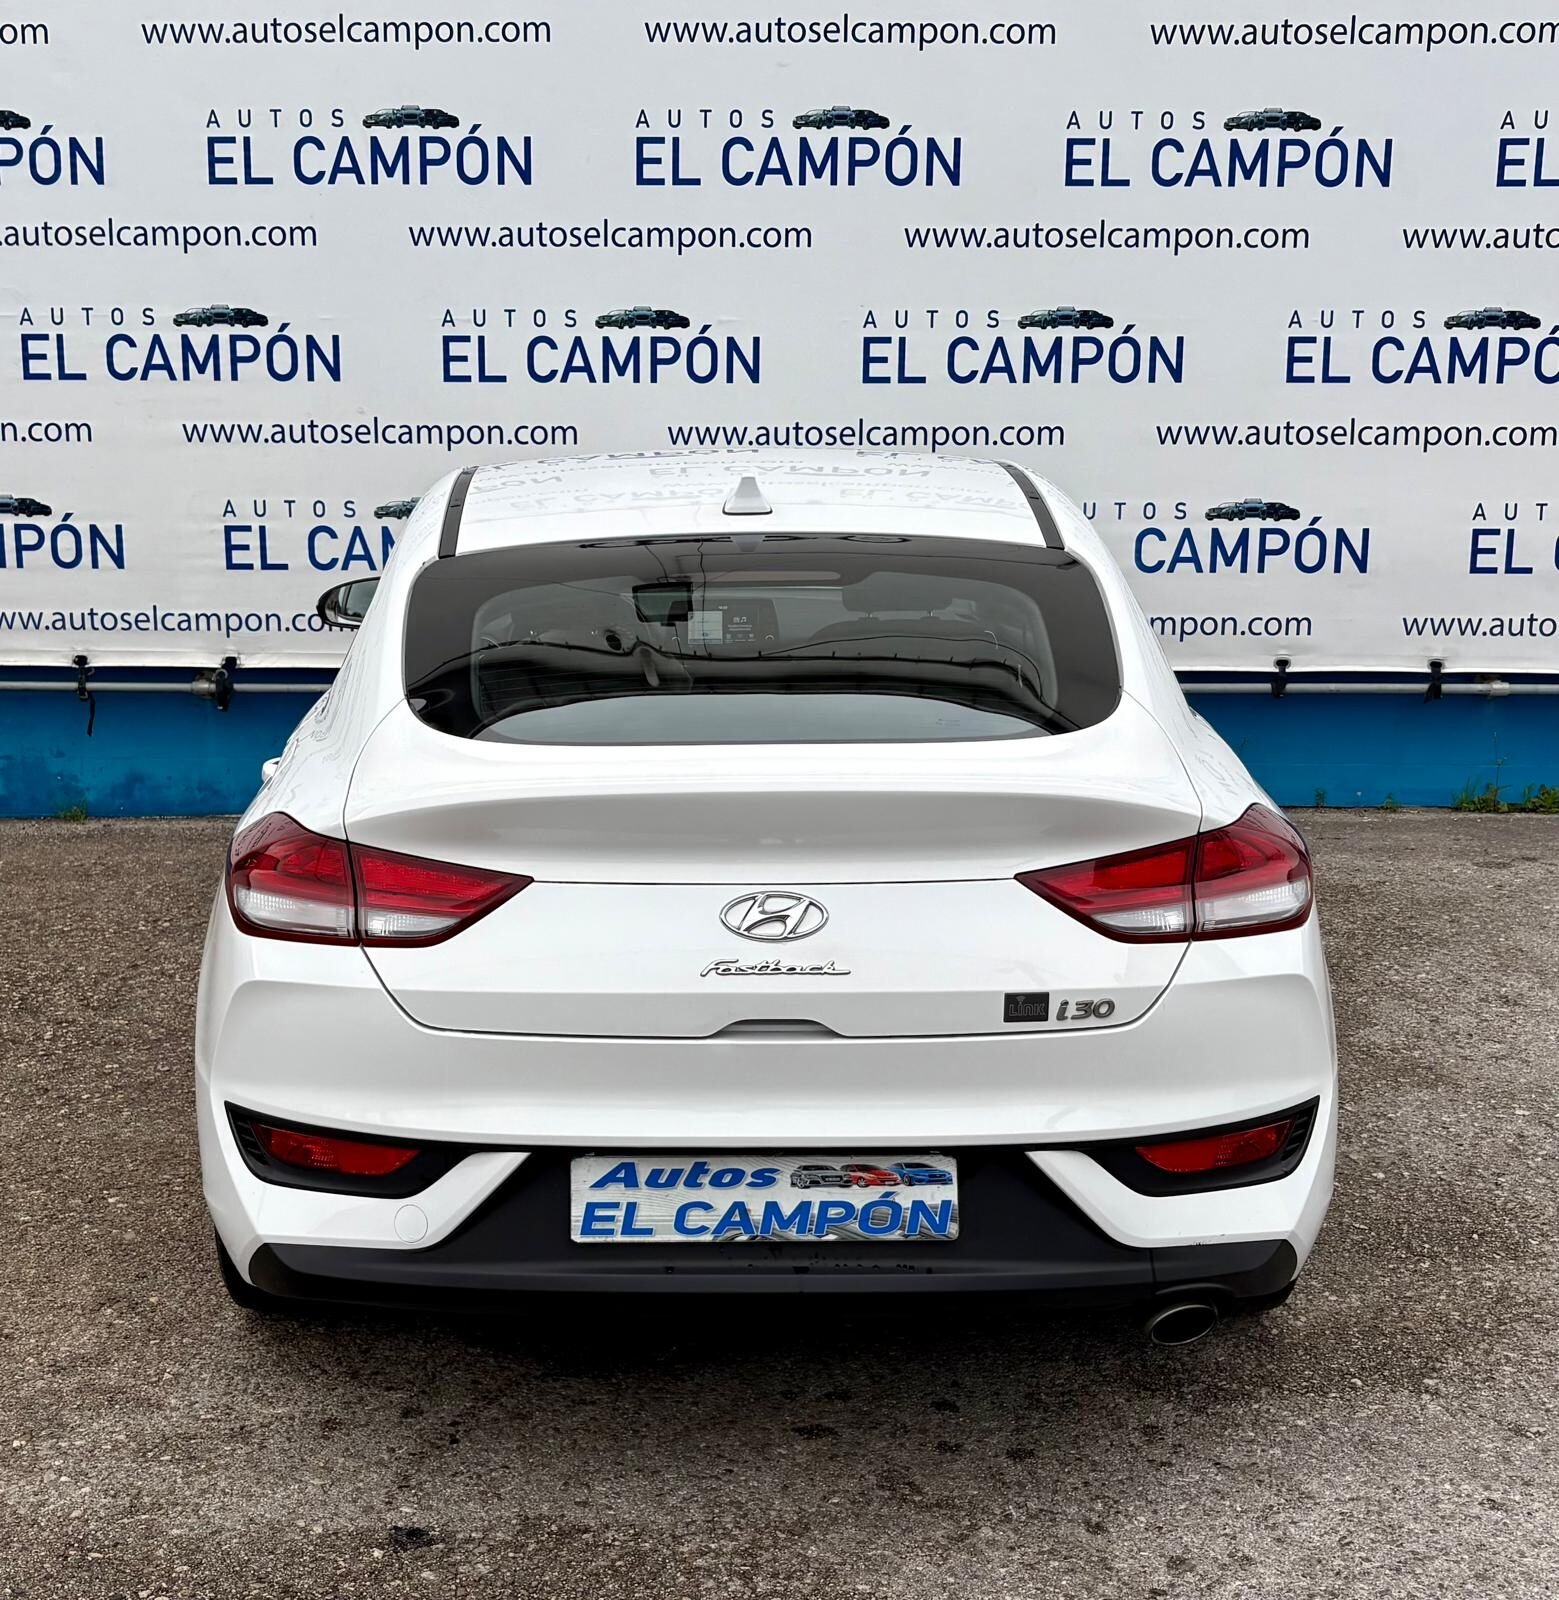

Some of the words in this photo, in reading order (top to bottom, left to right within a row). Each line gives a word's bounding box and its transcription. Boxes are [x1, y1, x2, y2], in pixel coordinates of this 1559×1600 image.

[141, 13, 551, 51] www.autoselcampon.com
[644, 13, 1056, 52] www.autoselcampon.com
[1150, 14, 1559, 53] www.autoselcampon.com
[206, 108, 344, 129] AUTOS
[635, 108, 774, 129] AUTOS
[1066, 110, 1205, 130] AUTOS
[207, 135, 274, 185] EL
[293, 124, 532, 186] CAMPÓN
[635, 136, 702, 186] EL
[721, 124, 962, 187] CAMPÓN
[1064, 137, 1131, 187] EL
[1151, 126, 1393, 188] CAMPÓN
[1495, 137, 1559, 188] EL
[408, 218, 812, 256] www.autoselcampon.com
[904, 219, 1309, 257] www.autoselcampon.com
[19, 307, 155, 326] AUTOS
[441, 308, 577, 328] AUTOS
[862, 309, 1000, 329] AUTOS
[1287, 309, 1426, 329] AUTOS
[20, 333, 88, 381] EL
[105, 323, 341, 382] CAMPÓN
[442, 335, 508, 383] EL
[526, 324, 761, 384] CAMPÓN
[862, 336, 927, 384] EL
[947, 325, 1185, 385] CAMPÓN
[1285, 336, 1351, 384] EL
[182, 416, 578, 452] www.autoselcampon.com
[667, 417, 1065, 453] www.autoselcampon.com
[1156, 417, 1559, 453] www.autoselcampon.com
[222, 499, 356, 519] AUTOS
[1083, 501, 1187, 521] UTOS
[0, 512, 125, 570] PÓN
[223, 524, 289, 571] EL
[1134, 516, 1370, 574] CAMPÓN
[1468, 528, 1534, 575] EL
[700, 958, 851, 978] Fastback
[1056, 998, 1115, 1021] i30
[589, 1160, 781, 1190] Autos
[579, 1200, 655, 1237] EL
[672, 1190, 955, 1237] CAMPÓN
